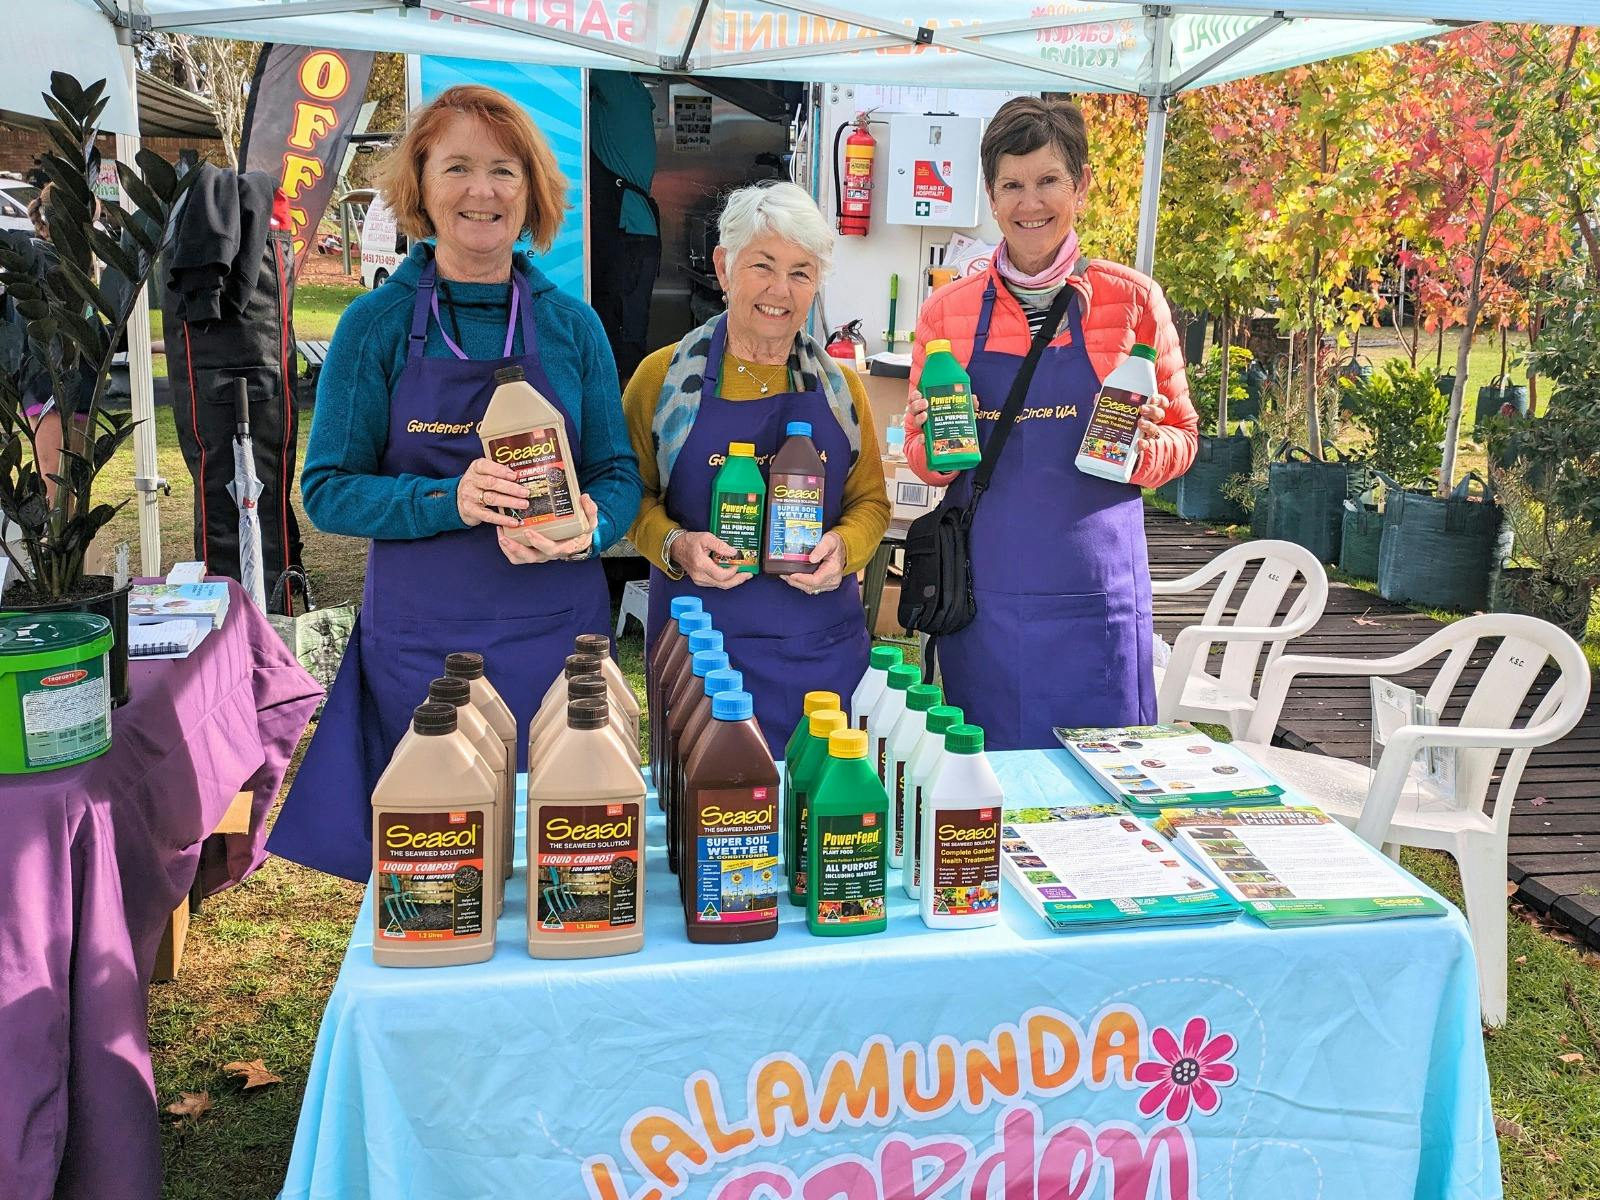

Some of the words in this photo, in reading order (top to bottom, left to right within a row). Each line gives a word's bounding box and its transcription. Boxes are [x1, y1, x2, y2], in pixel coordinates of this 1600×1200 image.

[1055, 404, 1077, 419] WA
[1099, 396, 1140, 416] Seasol
[495, 438, 557, 463] Seasol
[519, 465, 548, 477] COMPOST
[774, 485, 820, 500] Seasol
[801, 506, 817, 514] SOIL
[701, 804, 772, 826] Seasol
[546, 816, 632, 841] Seasol
[938, 822, 996, 841] Seasol
[386, 824, 476, 848] Seasol
[706, 838, 742, 846] SUPER
[746, 836, 770, 846] SOIL
[823, 830, 880, 846] PowerFeed
[597, 840, 630, 848] SOLUTION
[440, 848, 475, 856] SOLUTION
[707, 845, 768, 856] WETTER
[542, 855, 572, 864] LIQUID
[574, 854, 616, 864] COMPOST
[964, 855, 995, 863] Treatment
[382, 862, 413, 872] LIQUID
[414, 862, 459, 872] COMPOST
[825, 864, 840, 872] ALL
[841, 861, 878, 872] PURPOSE
